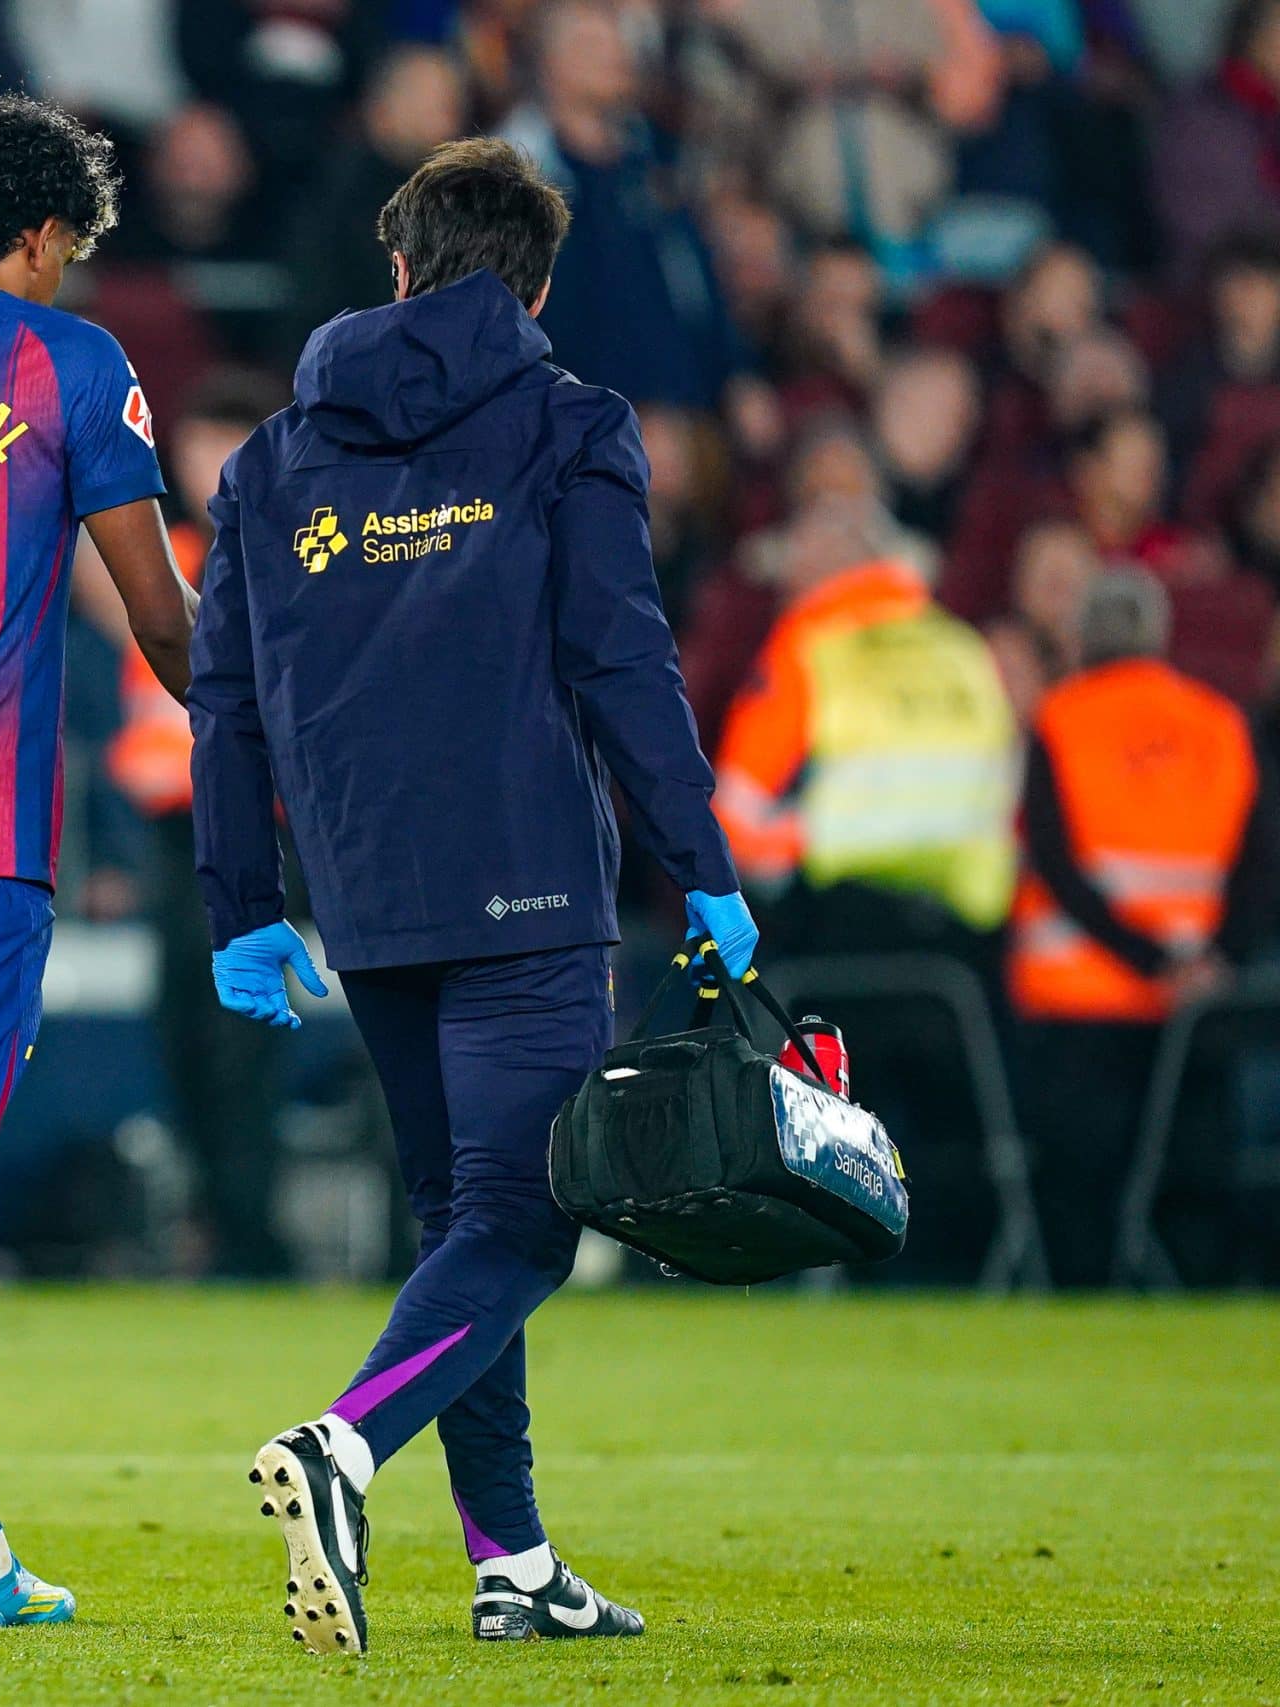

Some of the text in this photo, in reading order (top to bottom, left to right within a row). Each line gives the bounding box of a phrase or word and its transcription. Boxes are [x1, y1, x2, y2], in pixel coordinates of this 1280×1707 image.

[362, 498, 495, 536] Assistència
[362, 529, 452, 564] Sanitària
[834, 1142, 883, 1196] Sanitària
[479, 1615, 506, 1631] NIKE
